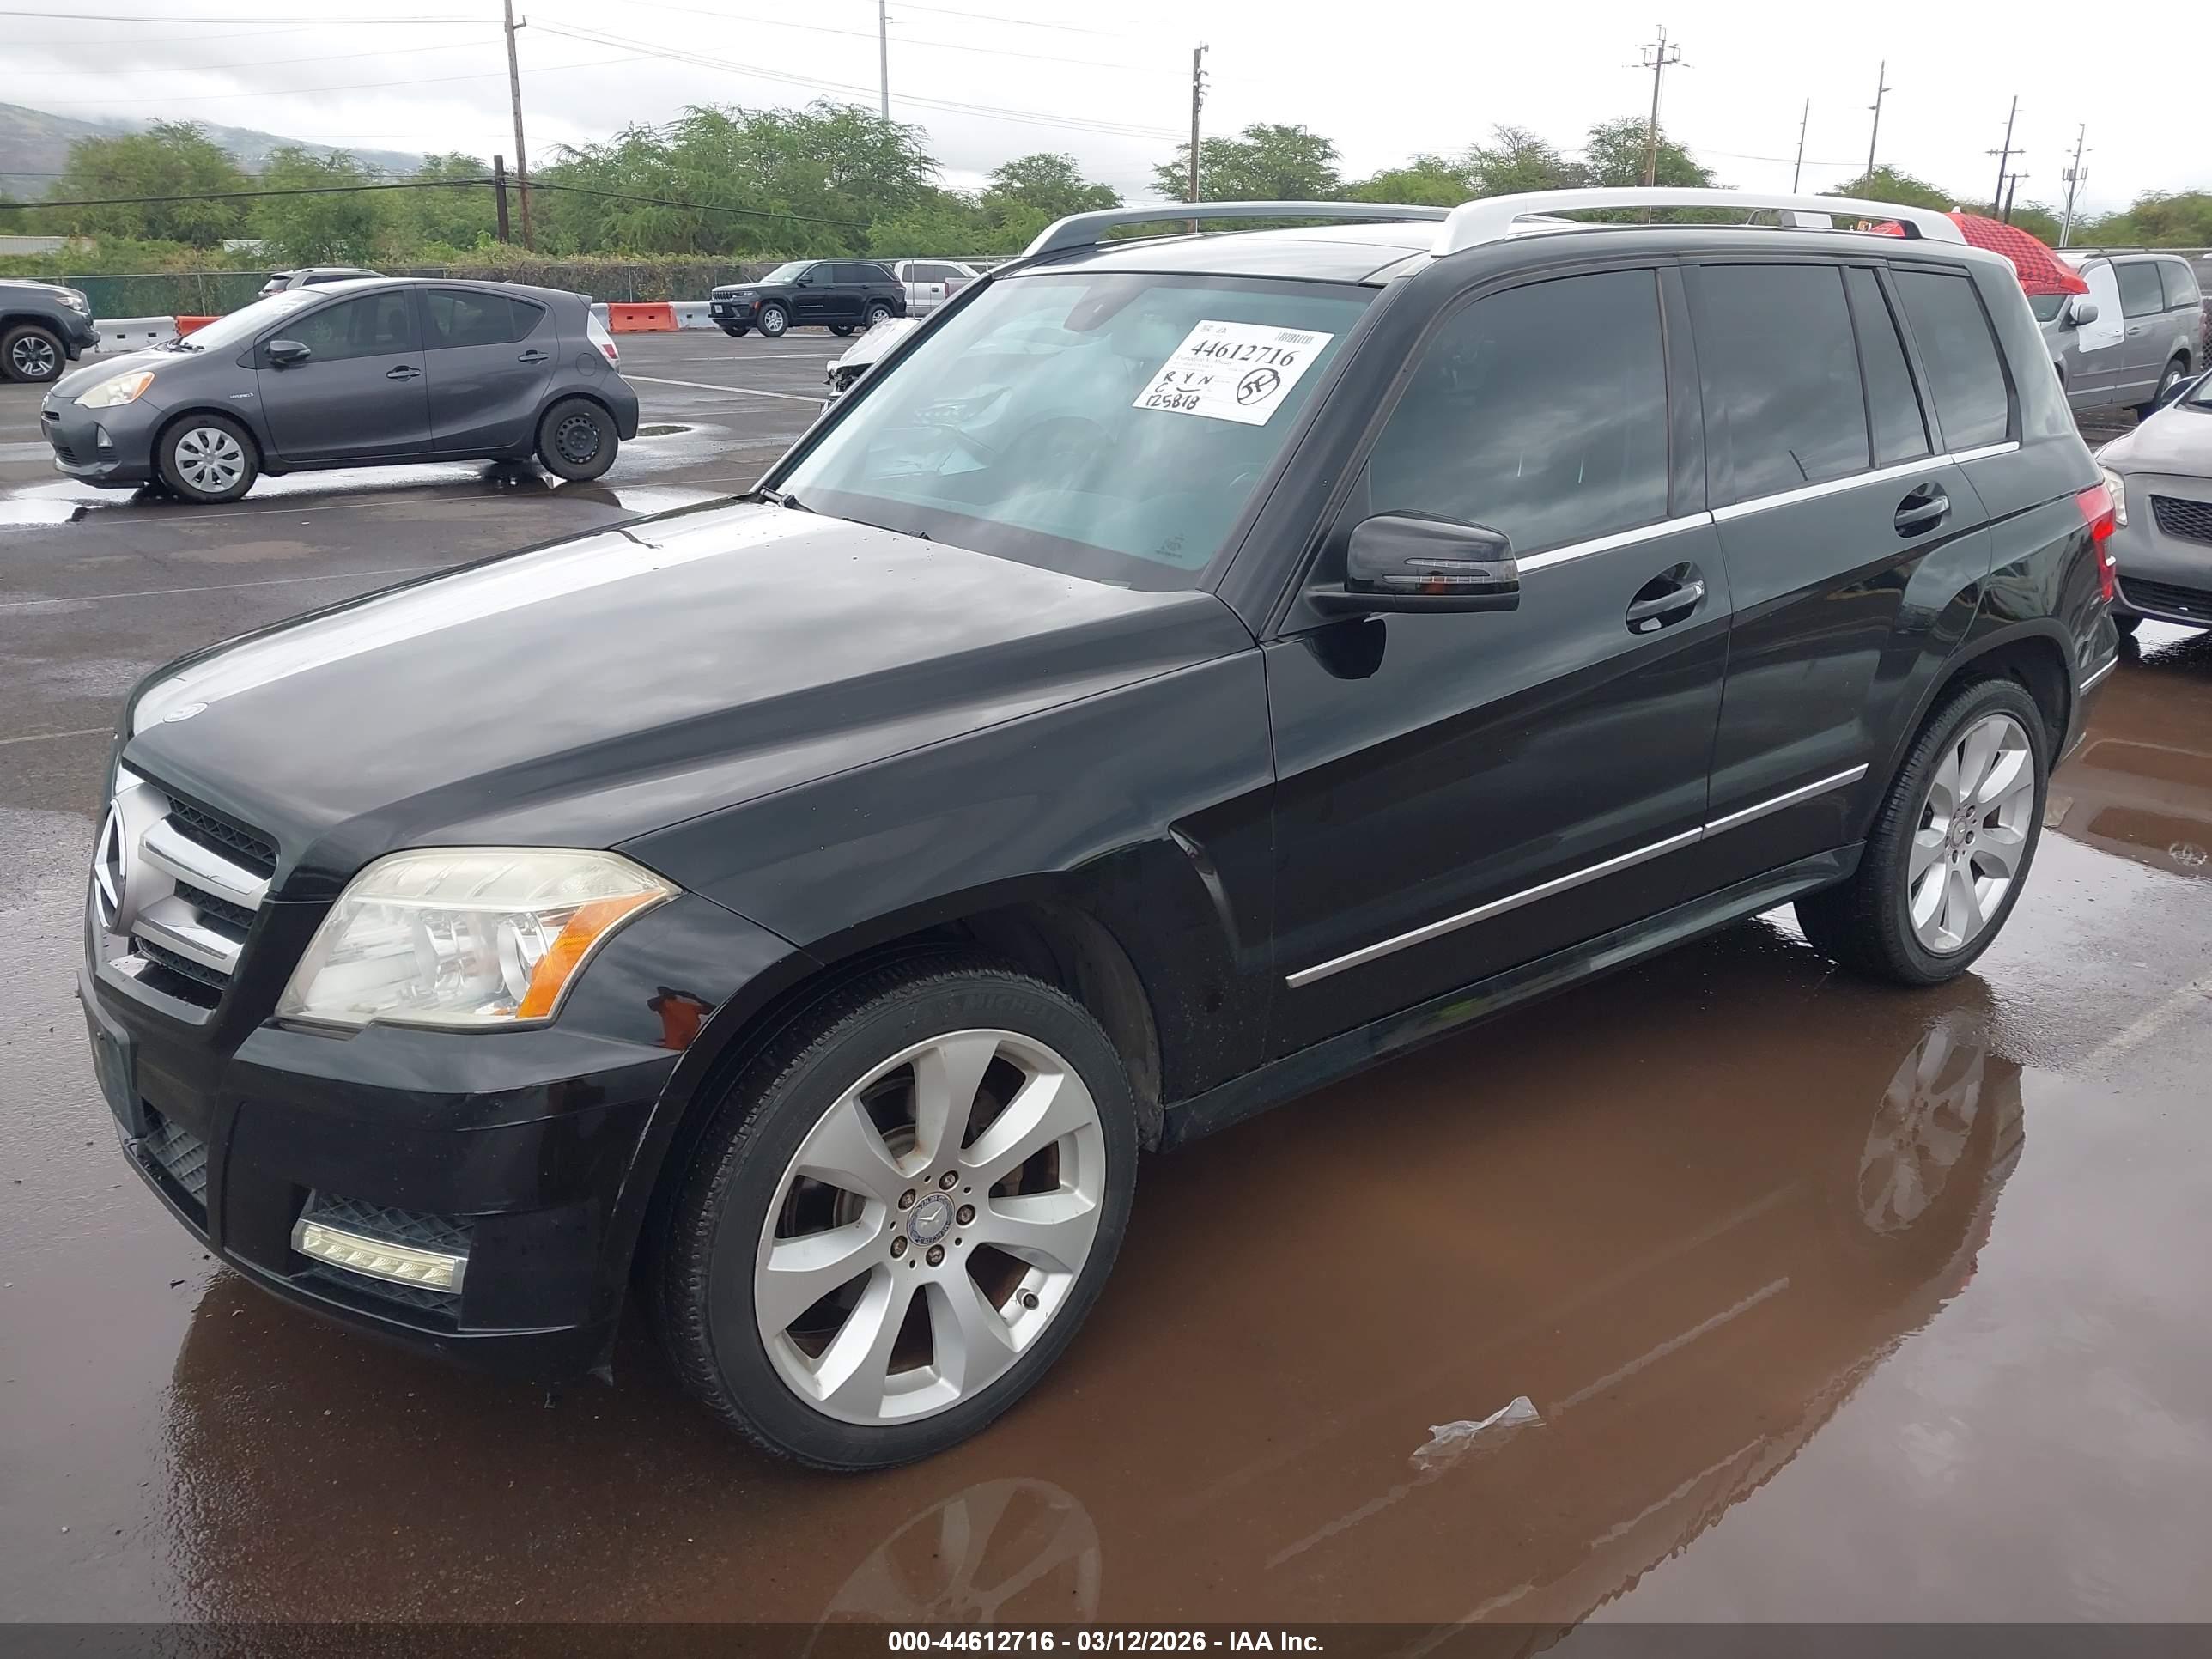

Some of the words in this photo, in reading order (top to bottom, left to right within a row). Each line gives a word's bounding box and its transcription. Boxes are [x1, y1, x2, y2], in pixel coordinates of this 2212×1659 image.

[1191, 339, 1301, 366] 44612716
[1163, 370, 1176, 382] R
[1183, 372, 1194, 385] Y
[1197, 375, 1215, 385] N
